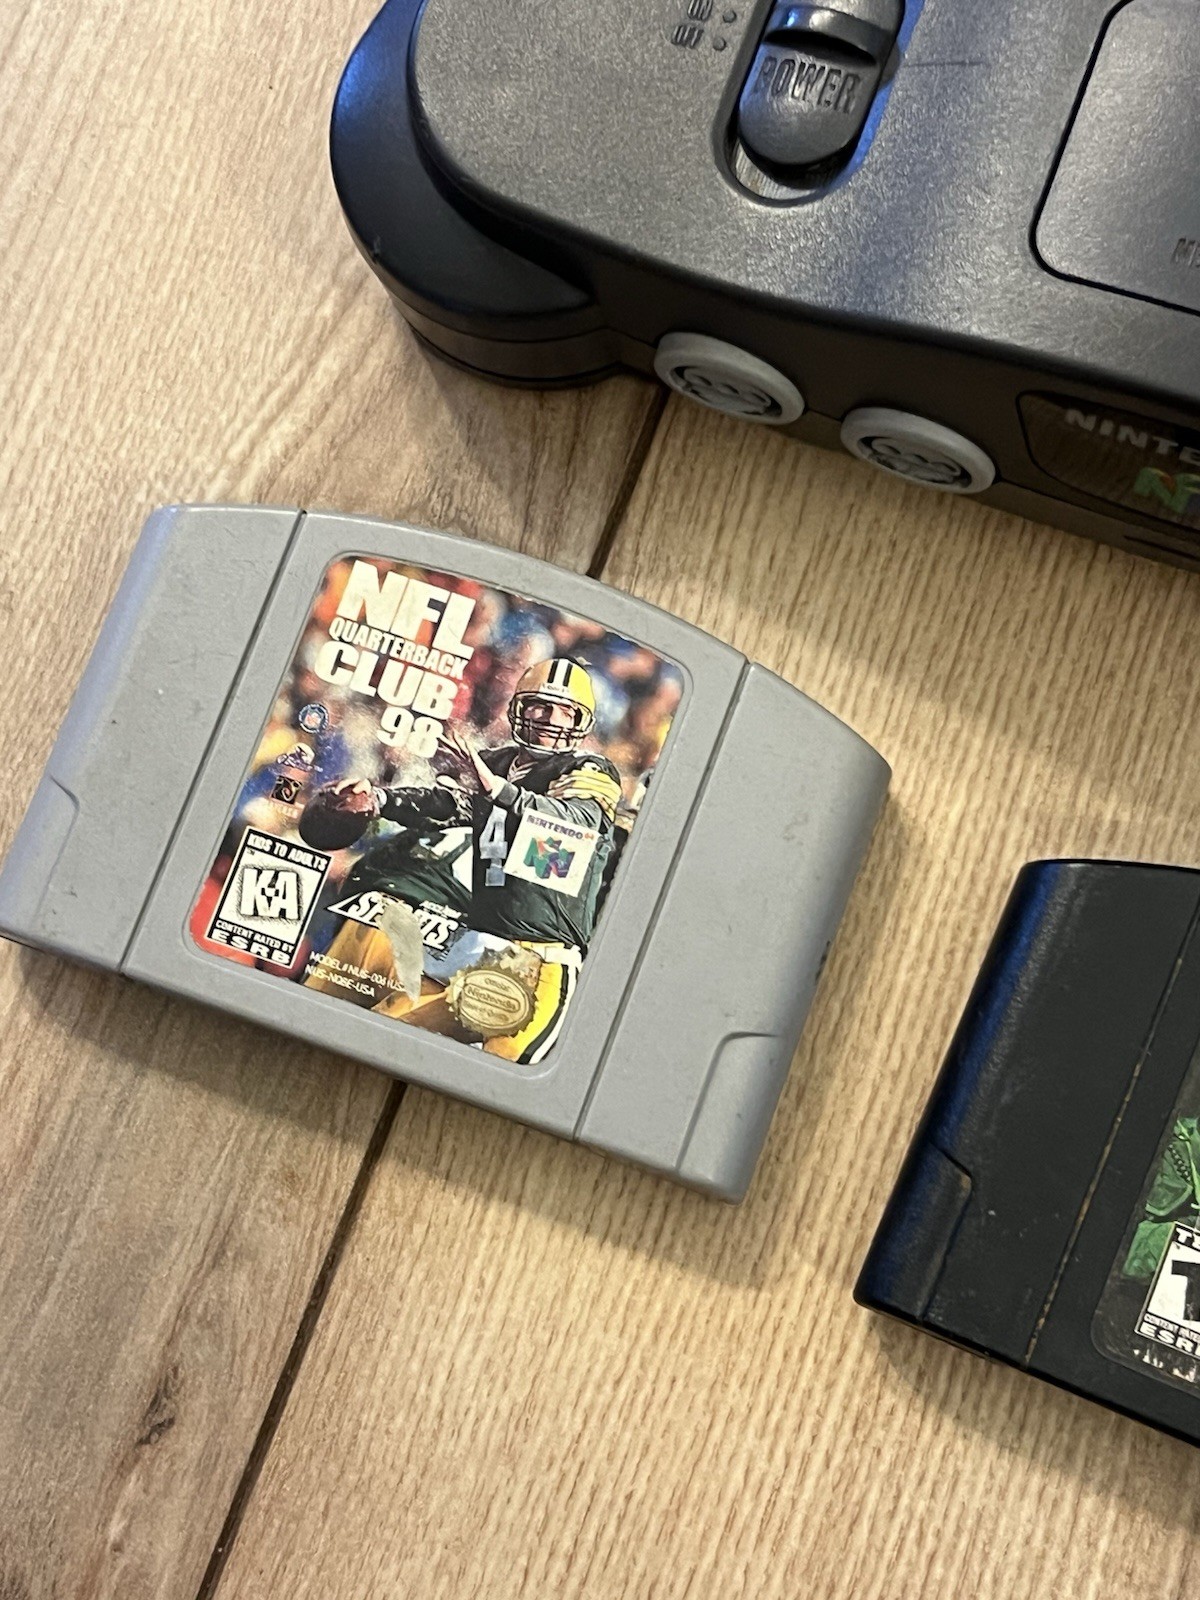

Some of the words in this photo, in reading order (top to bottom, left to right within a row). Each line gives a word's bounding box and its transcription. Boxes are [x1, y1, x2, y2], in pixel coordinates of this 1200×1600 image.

[755, 56, 861, 113] POWER
[336, 560, 476, 660] NFL
[328, 616, 468, 680] QUARTERBACK
[314, 640, 458, 720] CLUB
[376, 706, 444, 758] 98
[526, 814, 583, 840] NINTENDO
[273, 842, 288, 857] TO
[287, 848, 328, 871] ADULTS
[211, 928, 291, 965] ESRB
[216, 920, 254, 939] CONTENT
[253, 933, 281, 950] RATED
[281, 940, 295, 953] BY
[309, 951, 344, 971] MODEL
